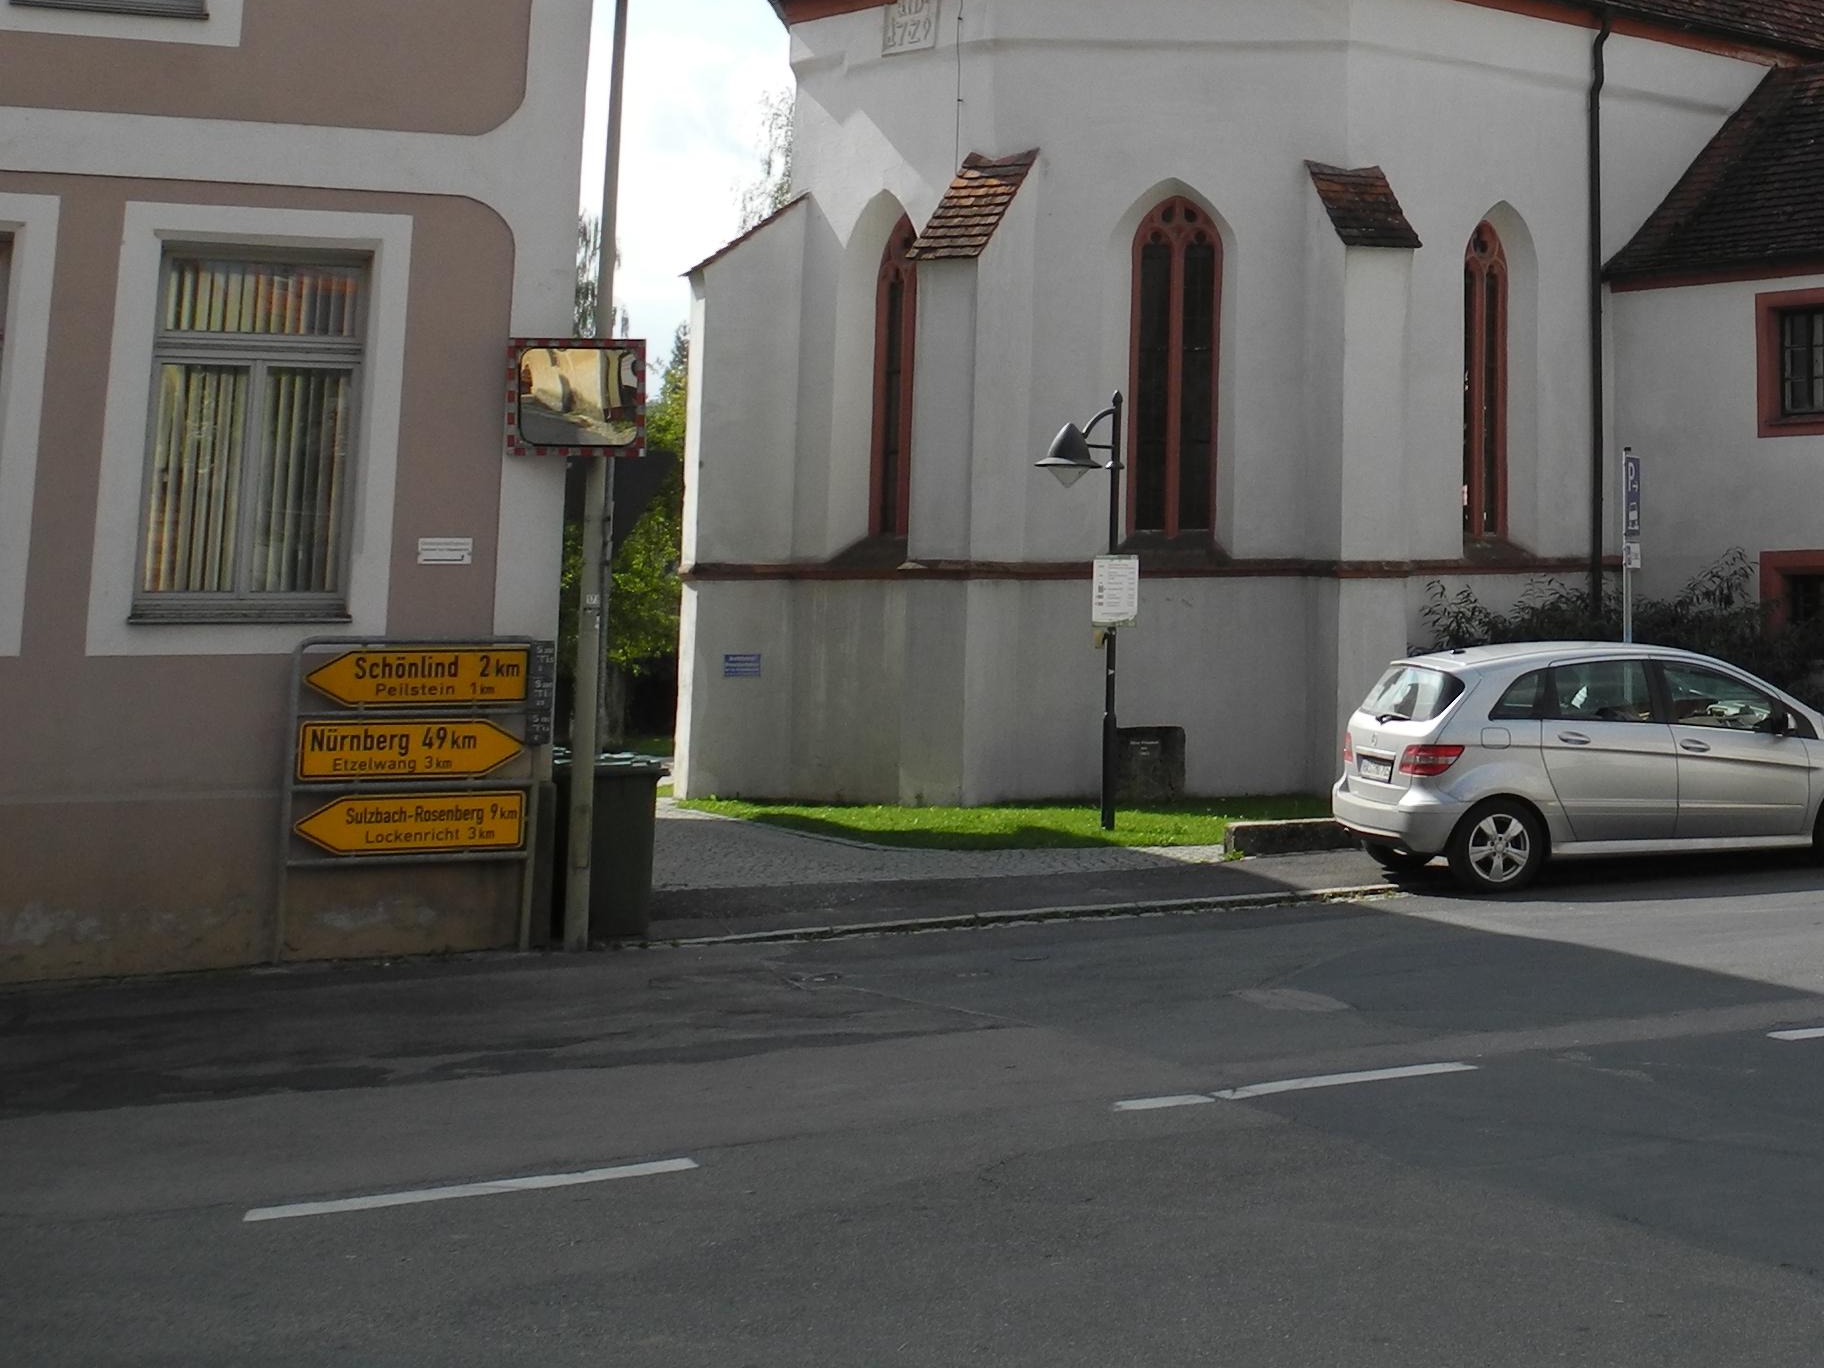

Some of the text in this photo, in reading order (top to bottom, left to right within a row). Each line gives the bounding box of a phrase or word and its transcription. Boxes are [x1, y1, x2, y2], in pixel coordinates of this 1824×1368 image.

[354, 655, 459, 679] Schönlind
[479, 655, 491, 677] 2
[495, 658, 520, 677] km
[375, 682, 496, 697] Peilstein 1 km
[310, 726, 477, 756] Nürnberg 49 km
[332, 756, 452, 773] Etzelwang 3 km
[345, 803, 518, 825] Sulzbach-Rosenberg 9 km
[365, 827, 495, 844] Lockenricht 3 km
